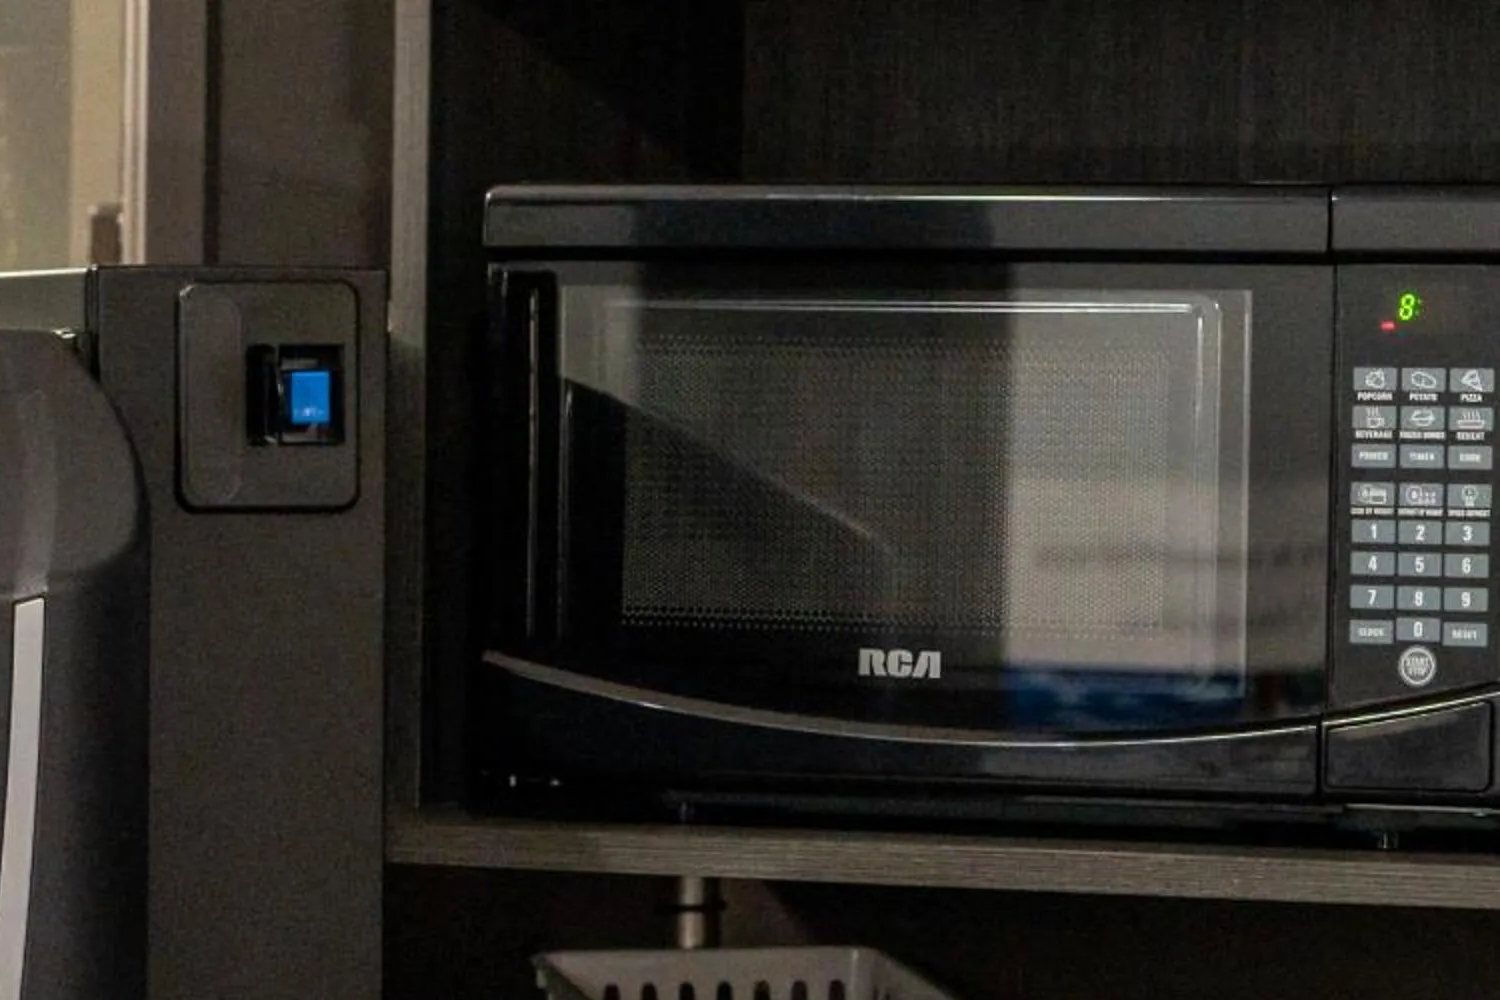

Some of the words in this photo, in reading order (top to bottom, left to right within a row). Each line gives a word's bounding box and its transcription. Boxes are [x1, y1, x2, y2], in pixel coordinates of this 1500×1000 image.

[1370, 523, 1377, 540] 1
[1416, 523, 1425, 541] 2
[1463, 525, 1473, 542] 3
[1368, 555, 1377, 572] 4
[1414, 556, 1425, 573] 5
[1461, 557, 1471, 575] 6
[1368, 589, 1377, 606] 7
[1414, 591, 1424, 608] 8
[1461, 591, 1471, 608] 9
[1413, 621, 1423, 638] 0
[858, 648, 941, 679] RCA
